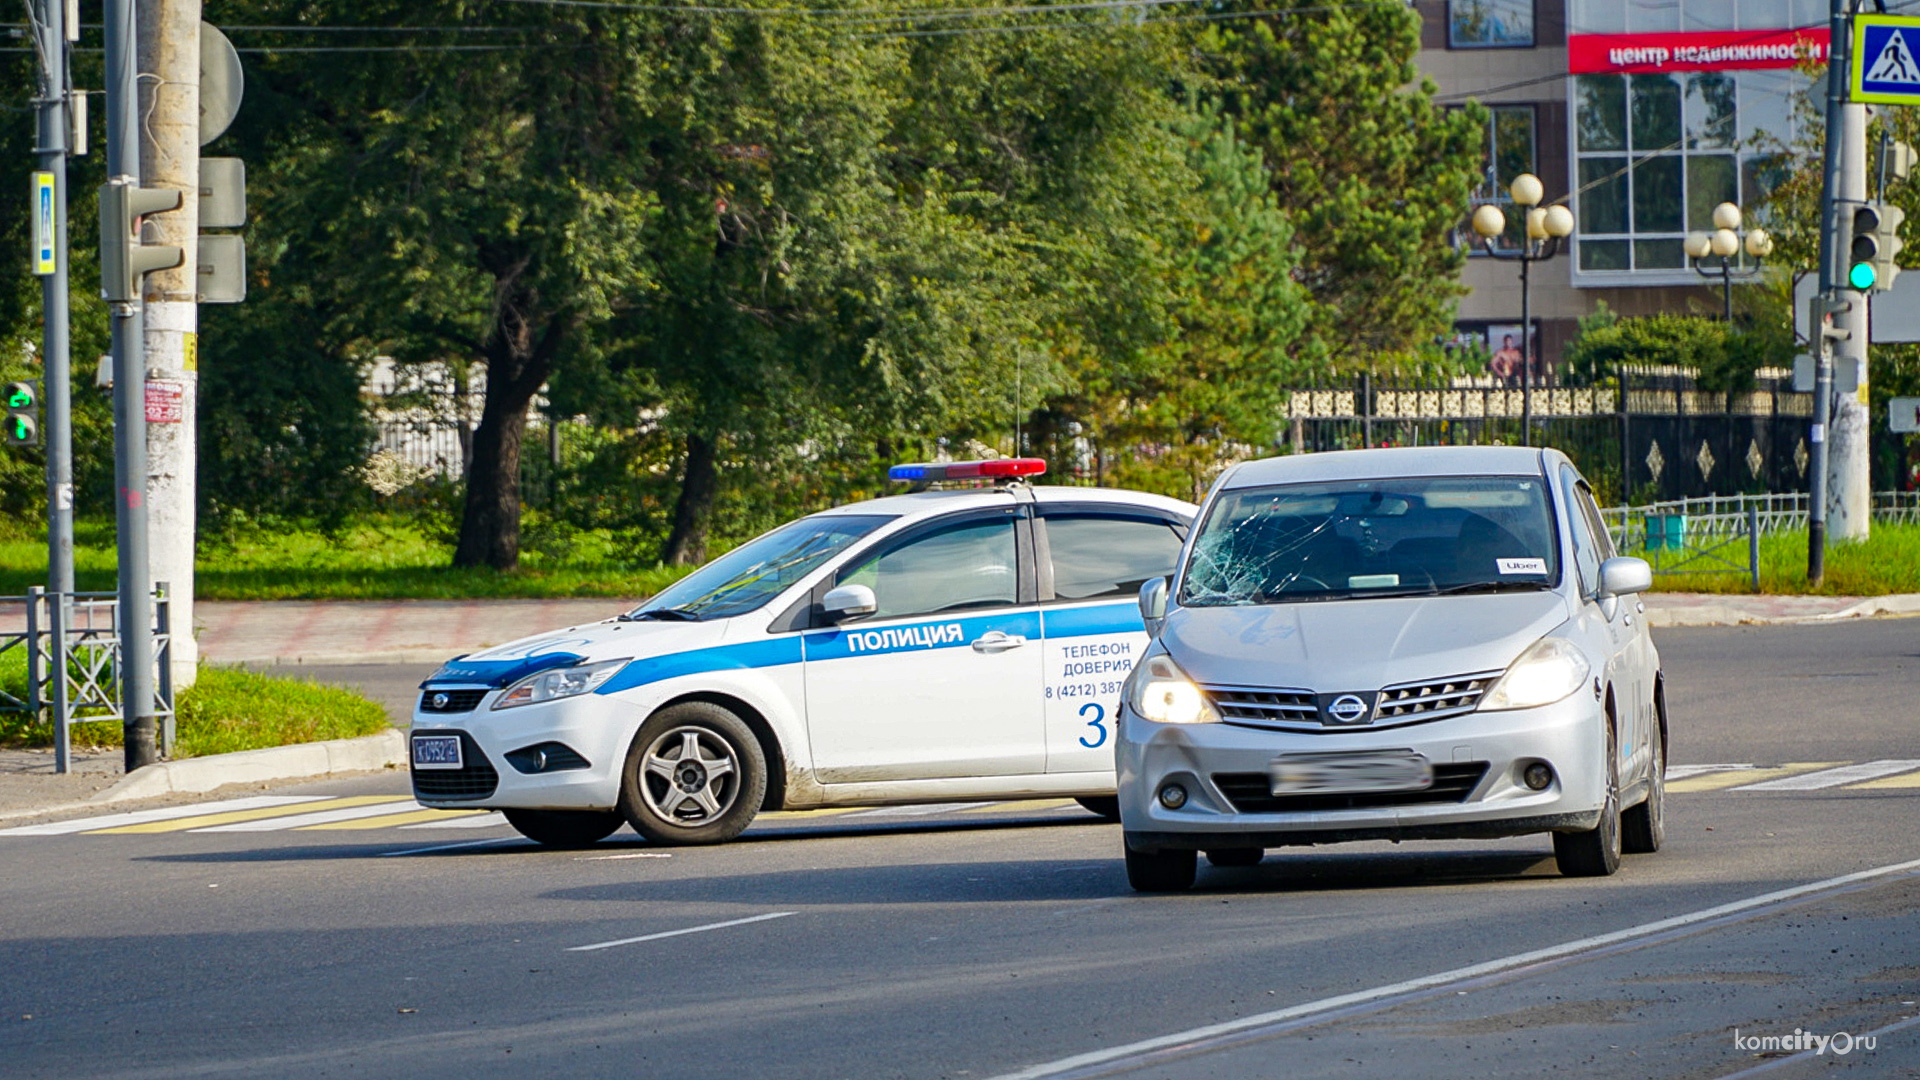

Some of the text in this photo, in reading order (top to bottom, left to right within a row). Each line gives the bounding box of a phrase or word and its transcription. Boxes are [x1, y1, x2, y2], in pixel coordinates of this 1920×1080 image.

[1609, 47, 1669, 66] центр
[1673, 43, 1822, 64] недвижимоси
[1506, 562, 1538, 570] Uber
[847, 623, 964, 652] ПОЛИЦИЯ
[1062, 643, 1130, 658] ТЕЛЕФОН
[1063, 659, 1132, 678] ДОВЕРИЯ
[1045, 686, 1053, 699] 8
[1057, 683, 1097, 700] (4212)
[1079, 702, 1107, 748] 3
